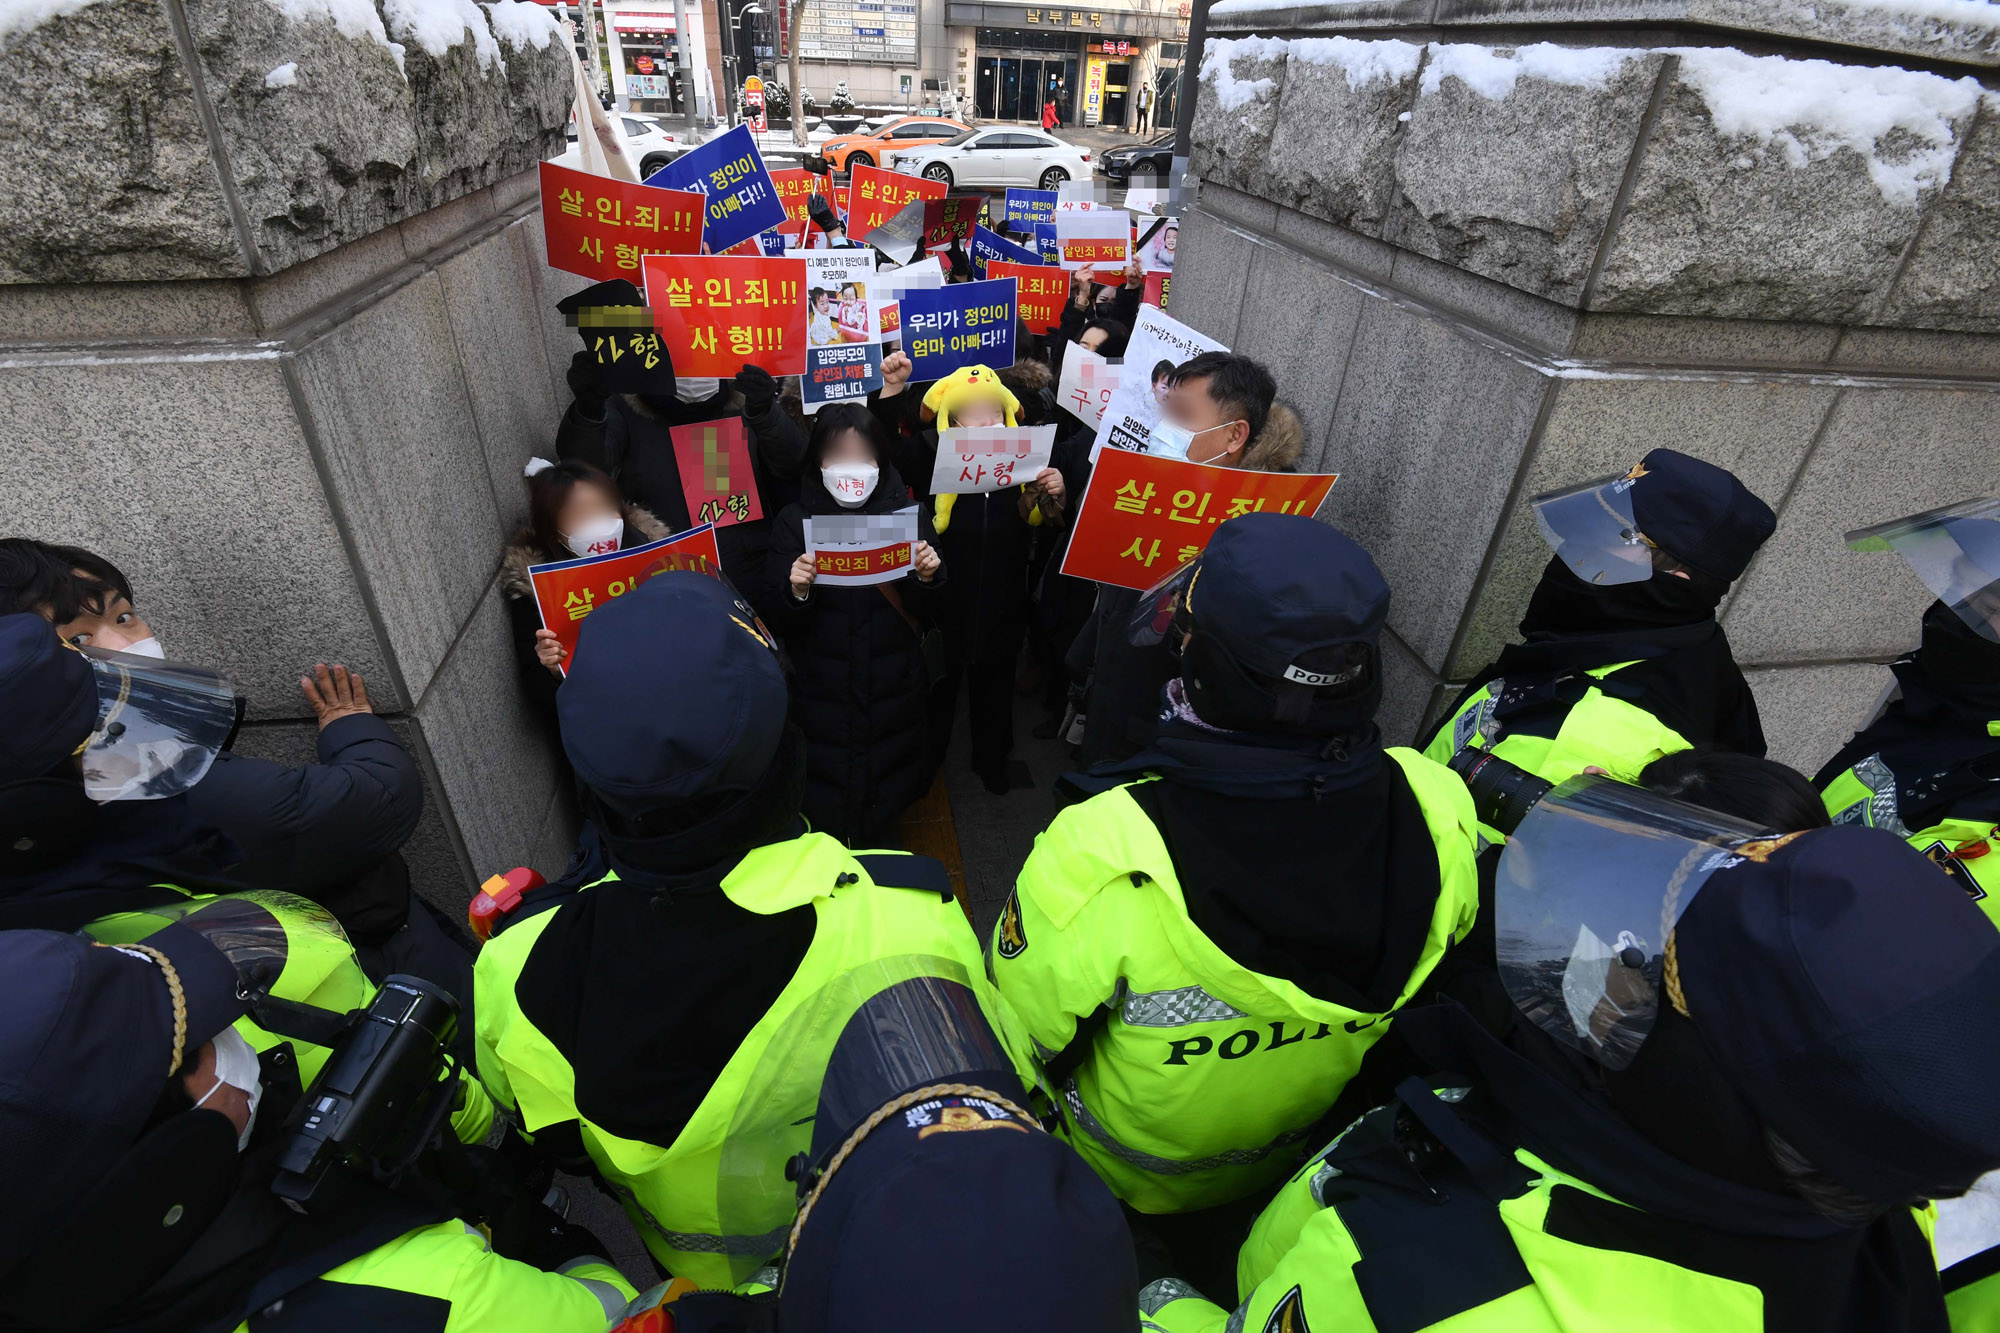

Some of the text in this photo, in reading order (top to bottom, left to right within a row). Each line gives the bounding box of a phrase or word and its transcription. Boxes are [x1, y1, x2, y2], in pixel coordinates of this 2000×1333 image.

[1027, 9, 1102, 28] 남부빌딩
[1103, 40, 1130, 56] 녹취
[709, 154, 758, 191] 정인이
[558, 187, 693, 234] 살.인.죄.!!
[710, 182, 767, 220] 아빠다!!
[1008, 199, 1054, 211] 우리가 정인이
[798, 205, 809, 221] 형
[1008, 212, 1022, 221] 엄마
[579, 236, 605, 263] 사
[1064, 246, 1096, 258] 살인죄
[816, 257, 830, 268] 예쁜
[830, 256, 844, 267] 아기
[844, 256, 870, 268] 정인이를
[821, 270, 848, 281] 추모하며
[665, 277, 799, 309] 살.인.죄.!!
[908, 303, 1010, 333] 우리가 정인이
[691, 326, 783, 355] 사 형!!!
[912, 328, 1008, 359] 엄마 아빠다!!
[817, 347, 866, 365] 입양부모의
[813, 363, 873, 383] 살인죄 처벌을
[824, 381, 866, 400] 원합니다.
[1122, 415, 1151, 439] 입양부
[817, 544, 912, 573] 살인죄 처벌
